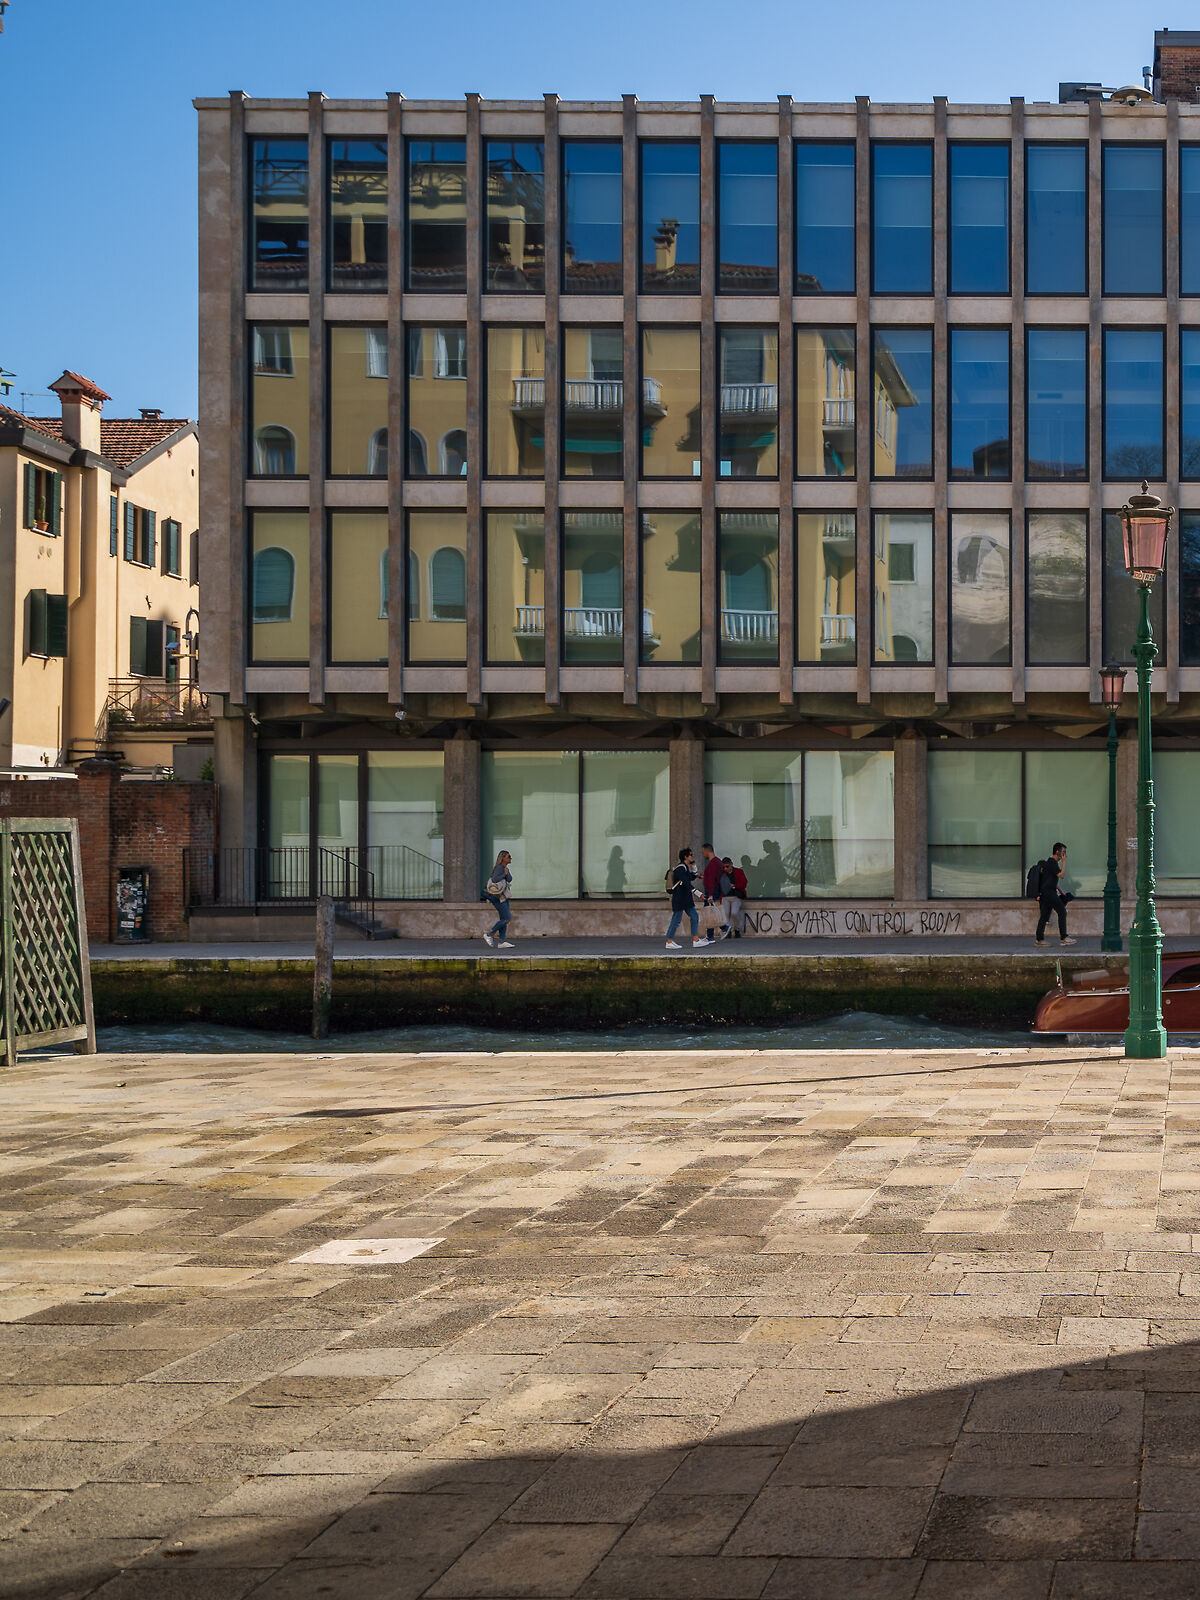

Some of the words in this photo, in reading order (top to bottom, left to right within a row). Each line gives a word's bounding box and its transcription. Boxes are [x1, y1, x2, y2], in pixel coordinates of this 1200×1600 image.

[743, 912, 773, 934] NO
[780, 910, 837, 934] SMART
[844, 911, 913, 934] CONTROL
[921, 911, 961, 934] ROOM
